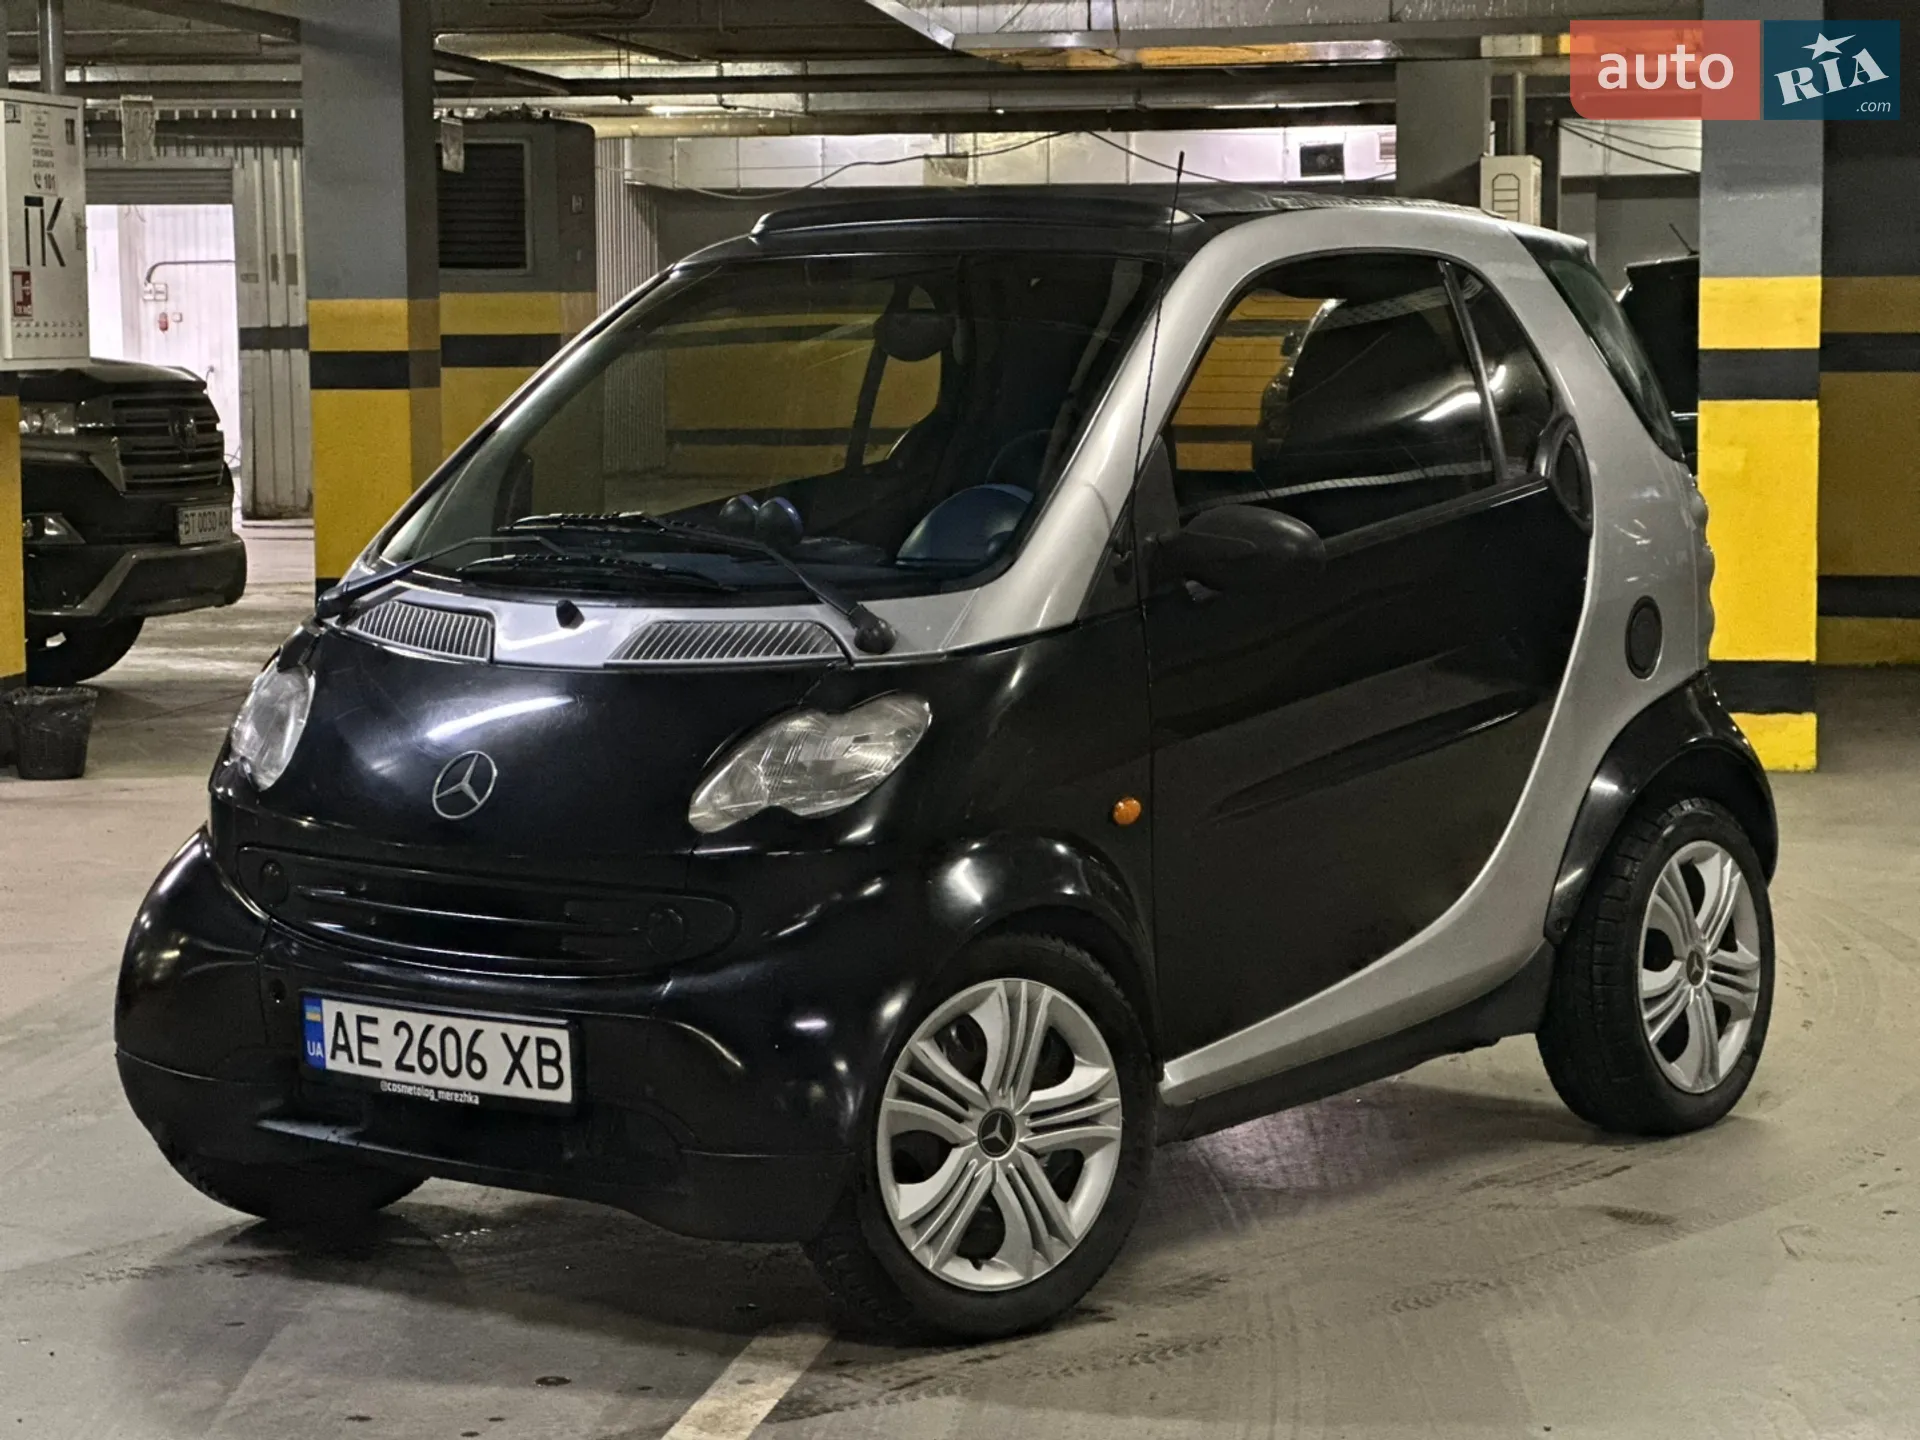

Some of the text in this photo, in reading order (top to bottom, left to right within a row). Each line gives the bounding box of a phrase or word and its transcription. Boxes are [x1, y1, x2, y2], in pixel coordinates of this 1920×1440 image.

[24, 195, 66, 267] ПК
[307, 1040, 325, 1059] UA
[329, 1011, 565, 1091] AE 2606 XB
[380, 1080, 480, 1105] @cosmetolog_merezhka
